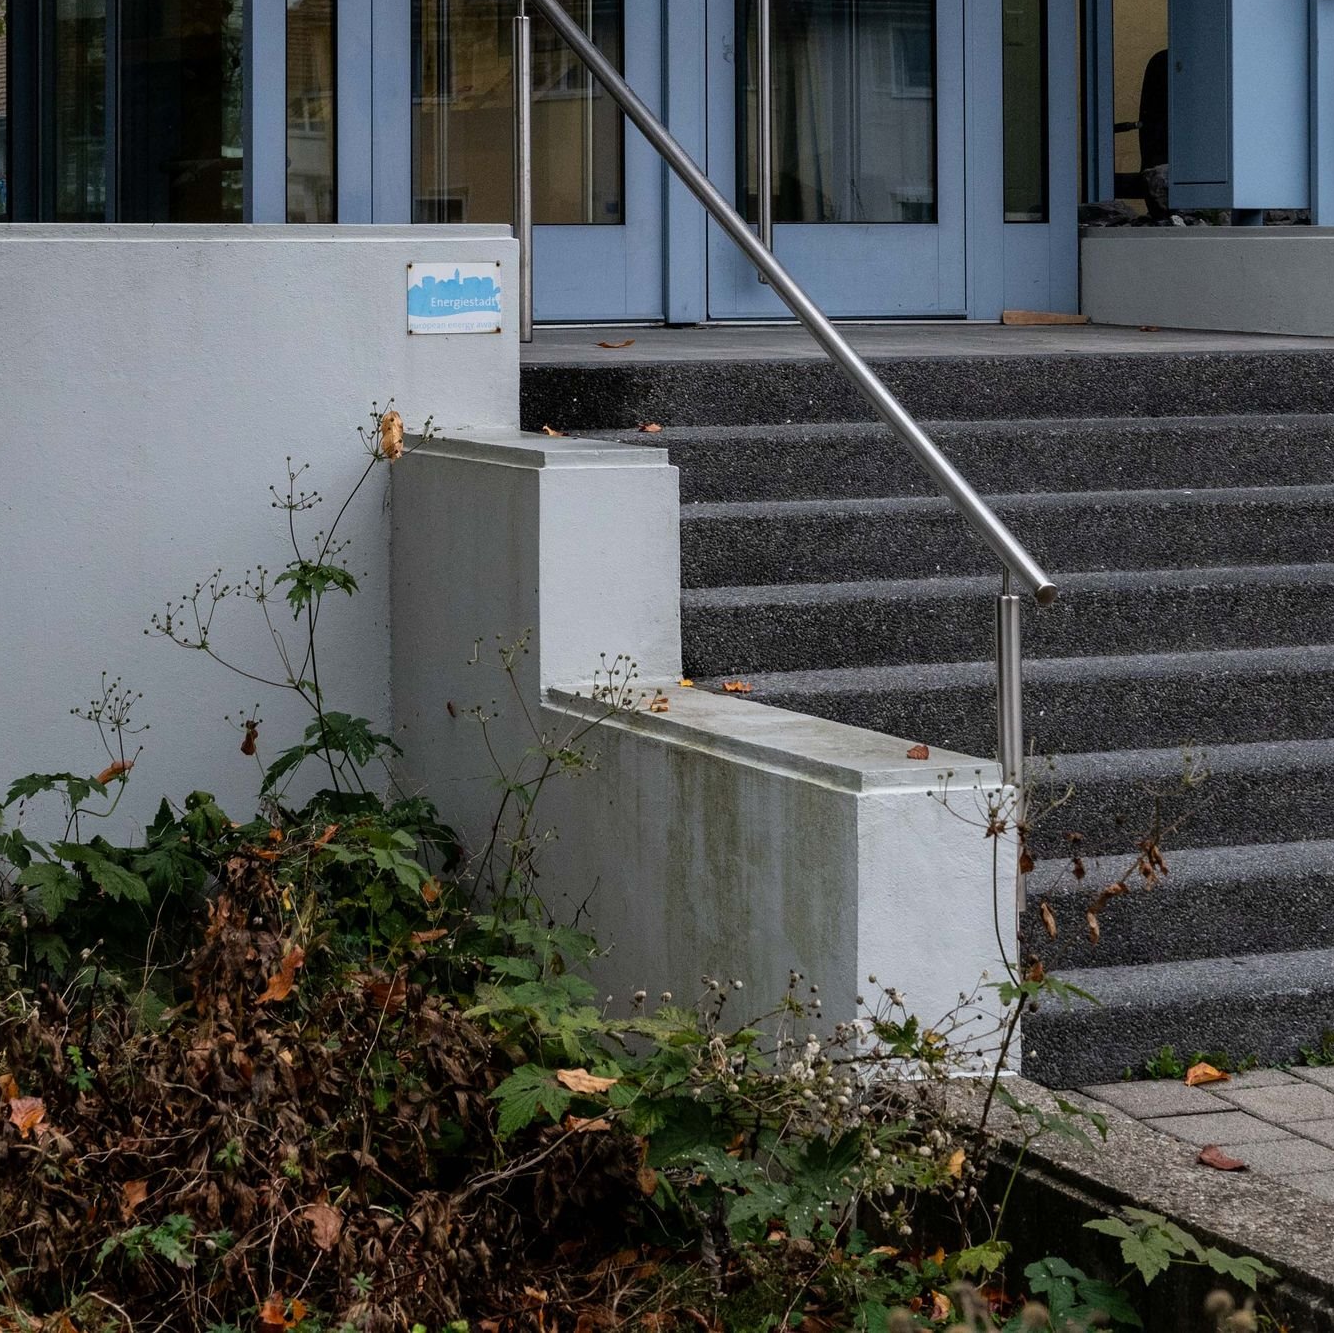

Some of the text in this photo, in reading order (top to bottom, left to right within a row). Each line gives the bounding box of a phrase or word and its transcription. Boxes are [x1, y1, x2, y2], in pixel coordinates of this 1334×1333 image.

[431, 296, 496, 309] Energiestadt
[410, 322, 446, 330] european
[447, 322, 474, 330] energy
